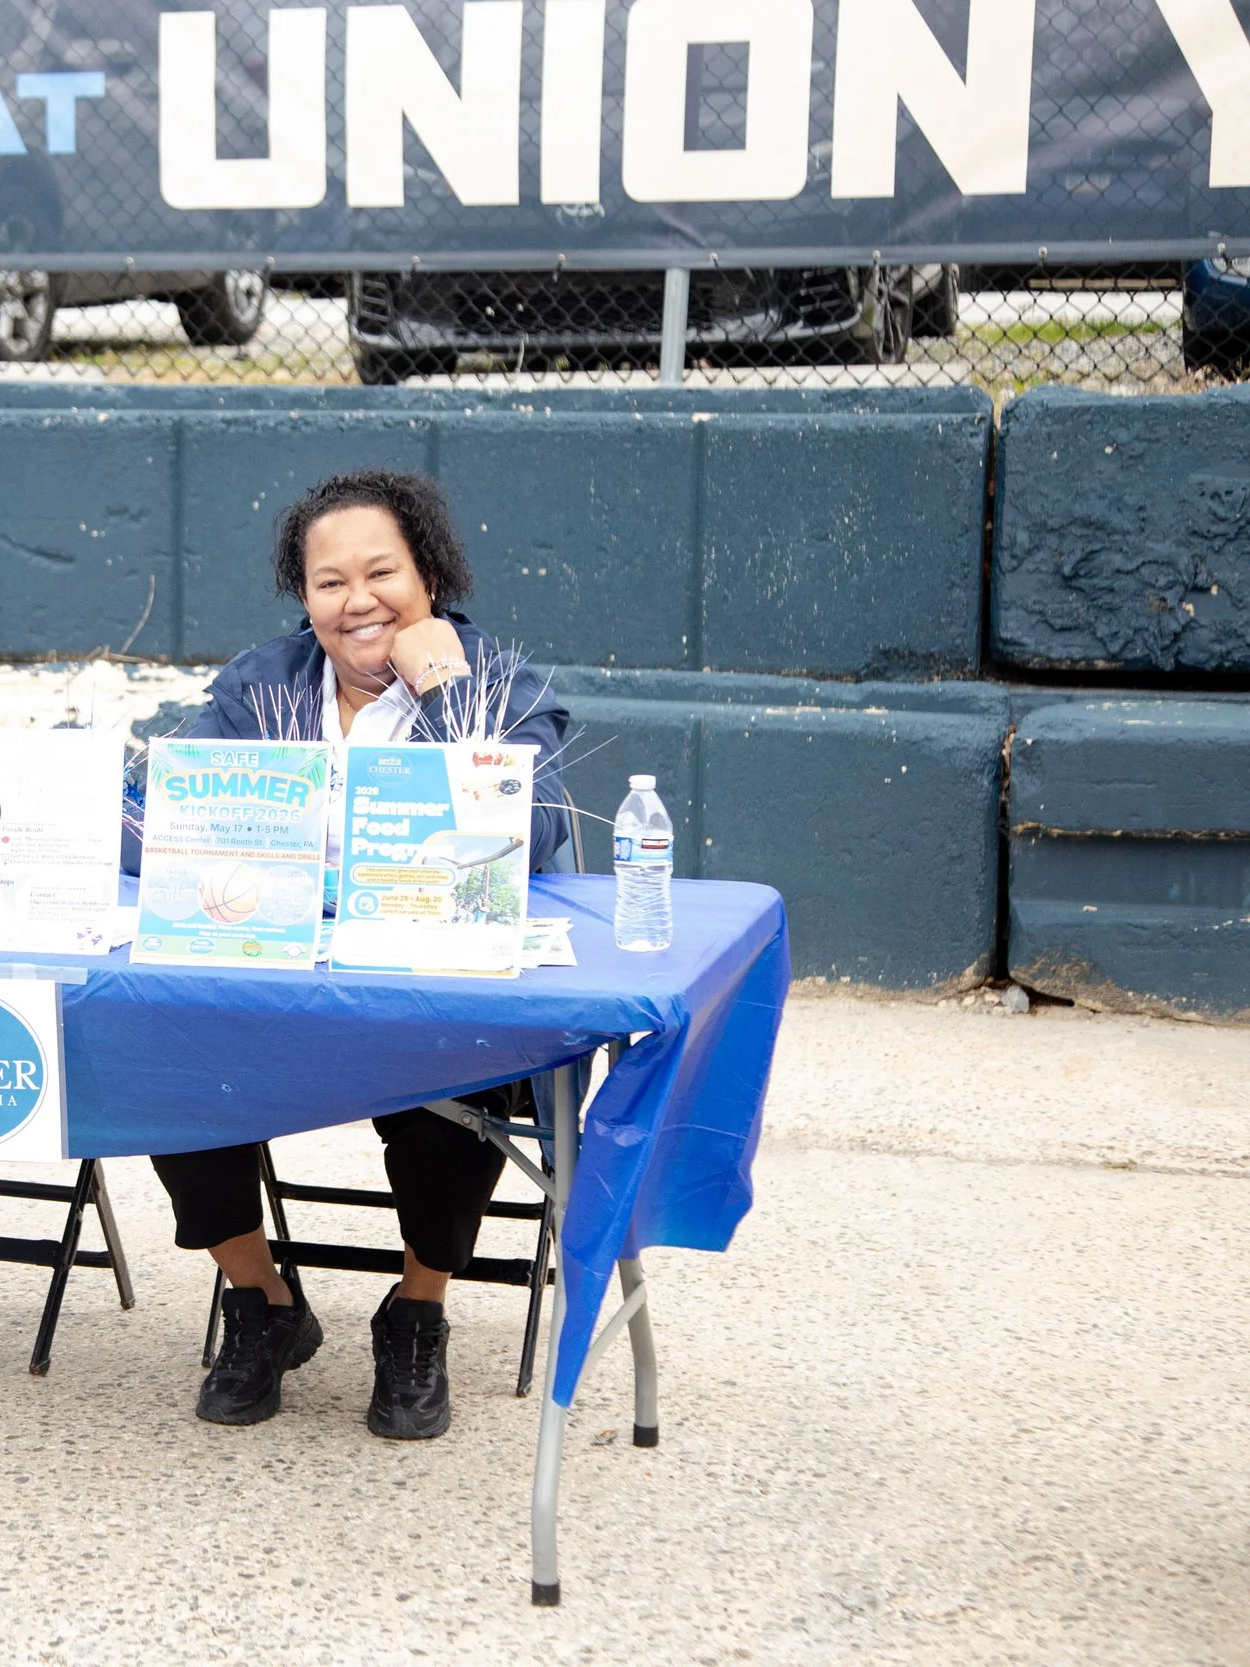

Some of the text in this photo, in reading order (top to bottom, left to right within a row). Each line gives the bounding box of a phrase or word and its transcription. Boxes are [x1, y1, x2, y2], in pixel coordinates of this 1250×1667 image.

[159, 0, 1036, 209] UNION
[211, 751, 258, 767] SAFE
[368, 766, 411, 775] CHESTER
[164, 772, 310, 808] SUMMER
[179, 804, 303, 822] KICKOFF 2026
[352, 796, 450, 817] Summer
[169, 822, 289, 834] Sunday, May 17 1-5 PM
[352, 816, 410, 836] Food
[152, 833, 184, 842] ACCESS
[185, 835, 211, 844] Center
[216, 837, 231, 845] 701
[254, 838, 262, 846] St
[270, 840, 302, 848] Chester,
[351, 837, 455, 861] Progr
[145, 846, 189, 855] BASKETBALL
[190, 849, 239, 857] TOURNAMENT
[256, 850, 280, 858] SKILLS
[298, 852, 321, 860] DRILLS
